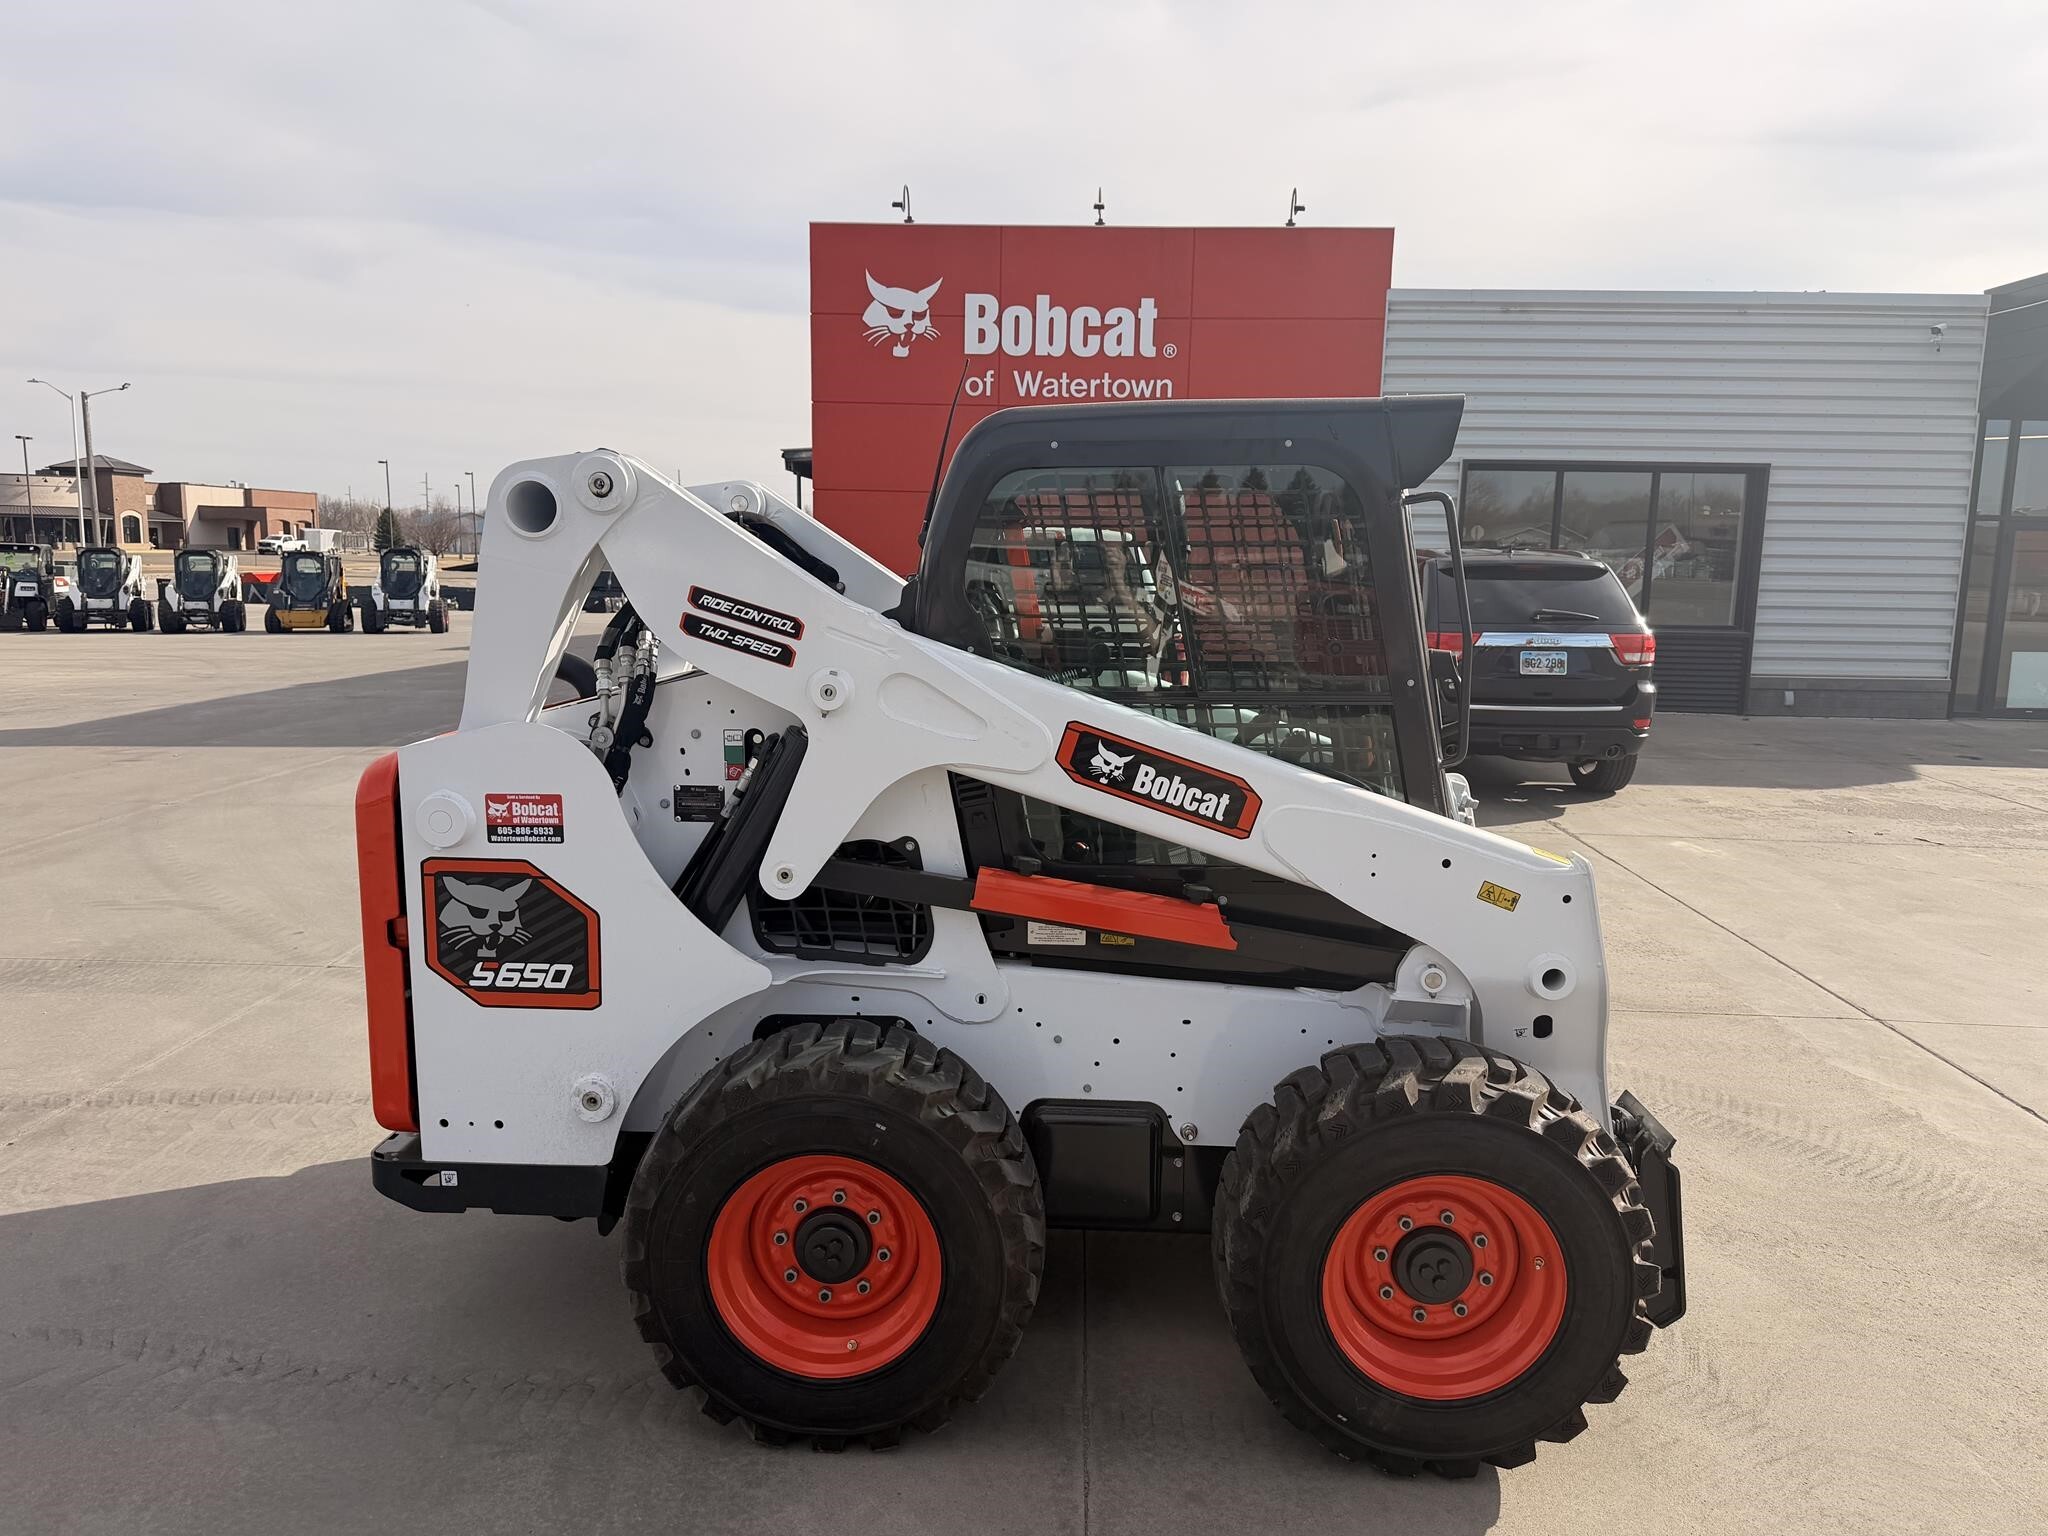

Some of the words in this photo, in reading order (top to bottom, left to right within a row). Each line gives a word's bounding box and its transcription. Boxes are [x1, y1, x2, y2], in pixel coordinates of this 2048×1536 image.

[964, 293, 1158, 358] Bobcat
[965, 370, 995, 397] of
[1013, 370, 1173, 398] Watertown
[699, 595, 735, 612] RIDE
[731, 605, 796, 634] CONTROL
[699, 623, 782, 657] TWO-SPEED
[1132, 763, 1230, 822] Bobcat
[512, 802, 559, 816] Bobcat
[512, 816, 520, 824] of
[521, 816, 559, 824] Watertown
[497, 827, 554, 835] 605-886-6933
[468, 961, 574, 989] S650
